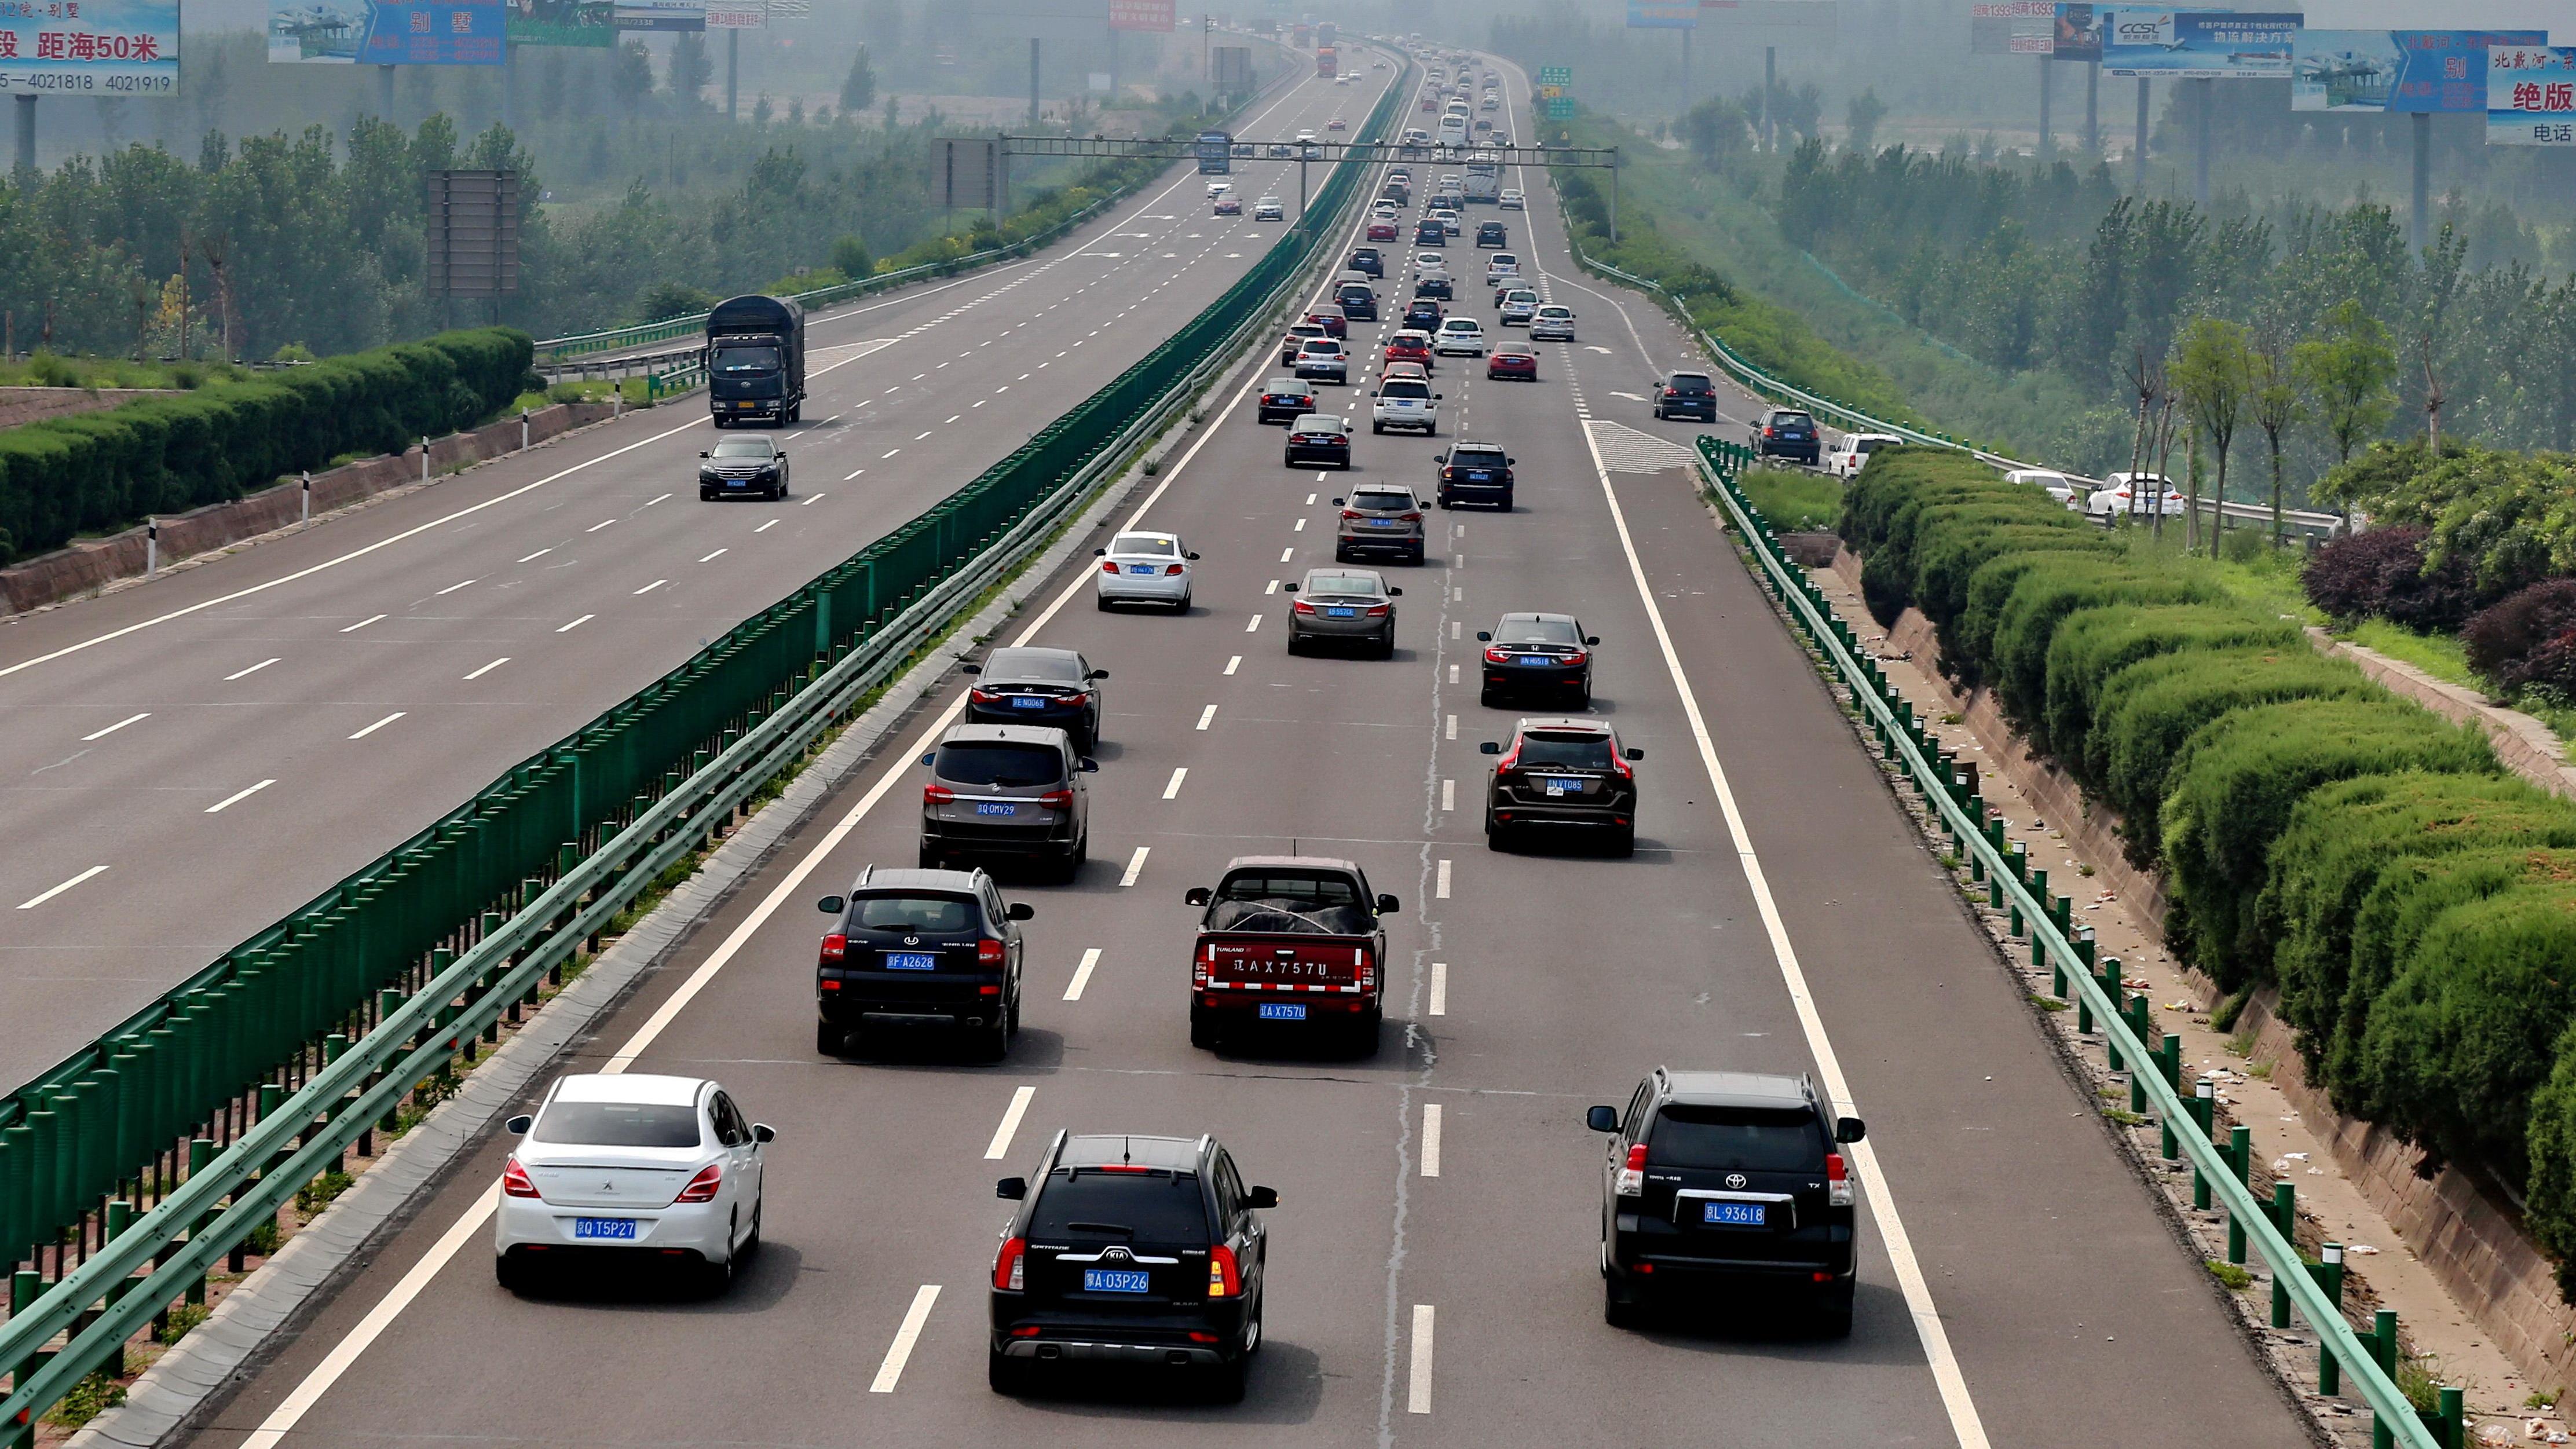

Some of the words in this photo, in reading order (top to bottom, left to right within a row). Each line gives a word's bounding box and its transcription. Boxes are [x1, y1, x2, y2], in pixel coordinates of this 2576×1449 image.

[2119, 23, 2160, 34] CCSL
[2214, 32, 2294, 43] 物流解决方案
[37, 31, 159, 62] 距海50米
[105, 76, 170, 91] 4021919
[2513, 82, 2576, 111] 绝版
[2534, 123, 2573, 142] 电话
